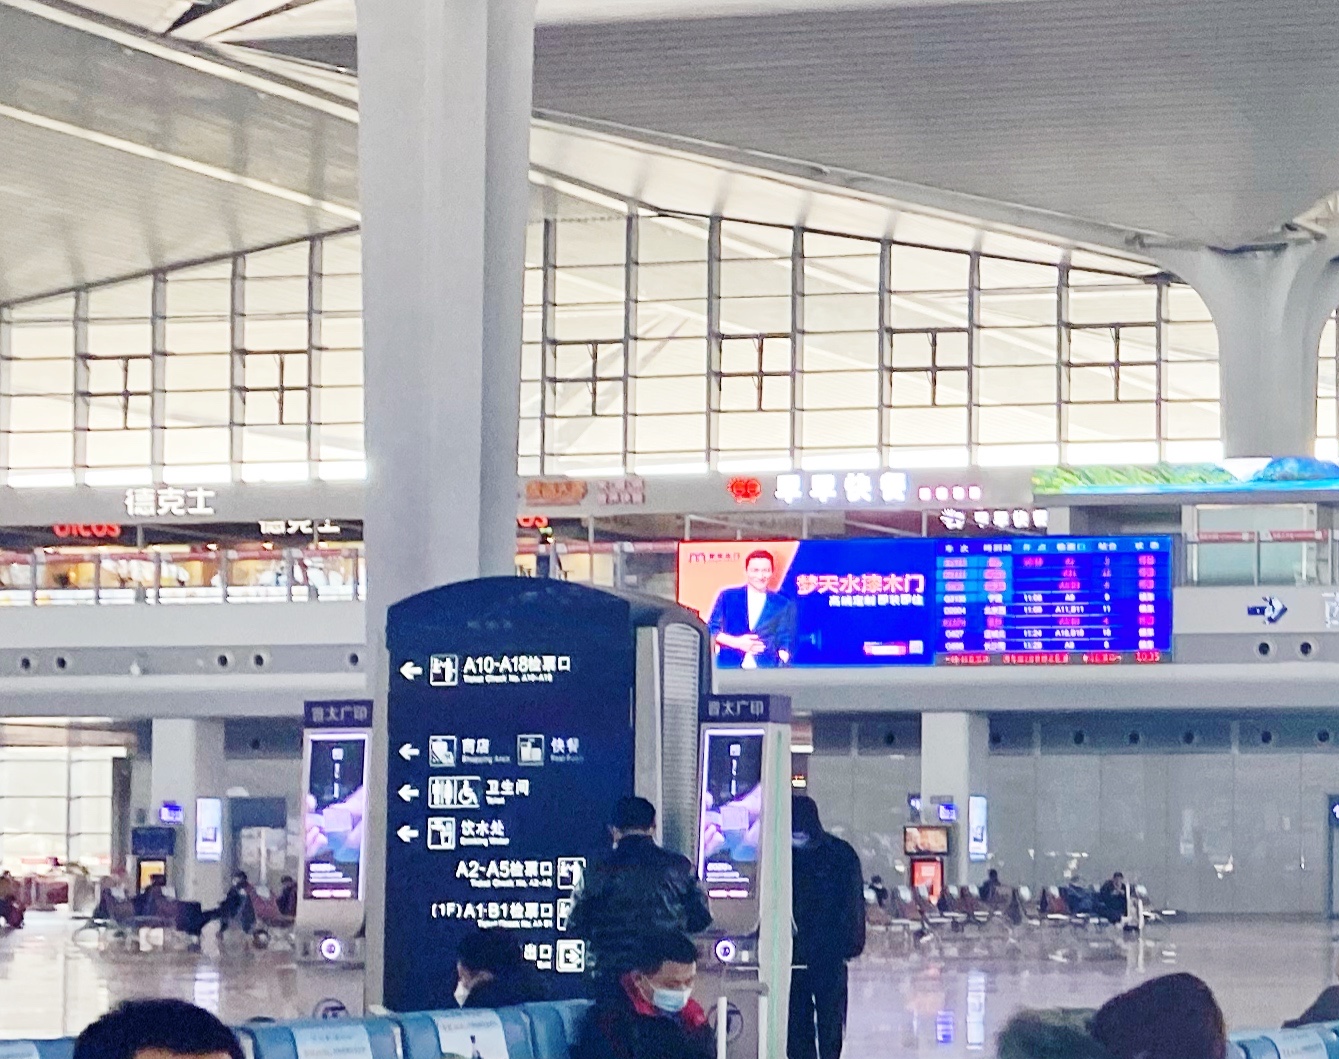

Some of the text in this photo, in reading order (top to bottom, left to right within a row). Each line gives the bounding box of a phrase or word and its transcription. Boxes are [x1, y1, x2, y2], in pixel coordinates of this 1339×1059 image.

[124, 487, 216, 516] 德克士
[796, 573, 925, 595] 梦天水漆木门
[463, 655, 571, 674] A10-A18检票口
[485, 778, 530, 796] 卫生间
[460, 819, 505, 837] 饮水处
[455, 860, 553, 879] A2-A5检票口
[523, 943, 553, 961] 出口
